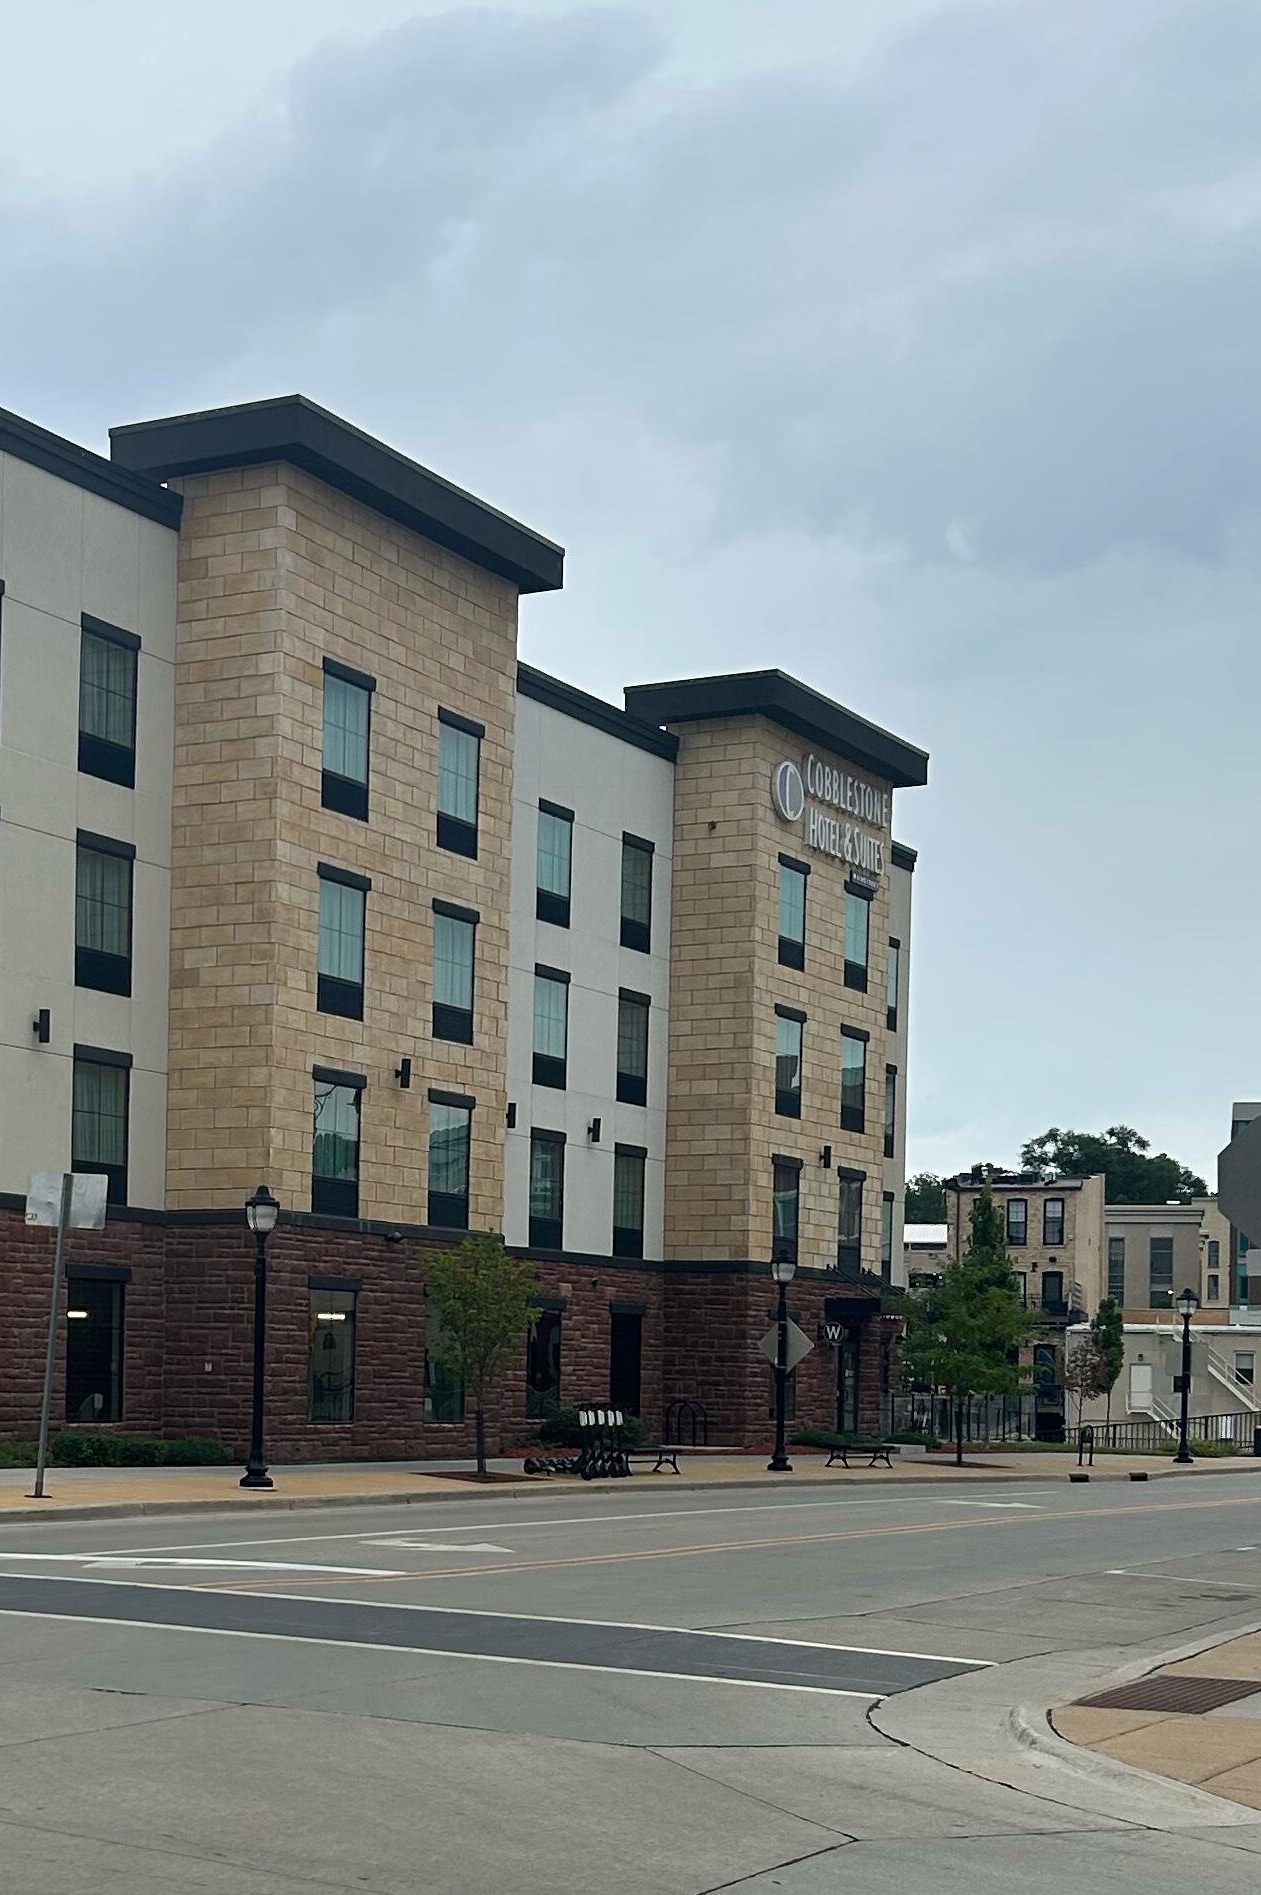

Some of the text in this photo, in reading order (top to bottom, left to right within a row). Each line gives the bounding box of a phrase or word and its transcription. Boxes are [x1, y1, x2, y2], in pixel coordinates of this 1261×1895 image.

[807, 753, 888, 828] COBBLESTONE
[809, 806, 842, 858] HOTEL
[853, 827, 885, 875] SUITES
[826, 1325, 841, 1340] W
